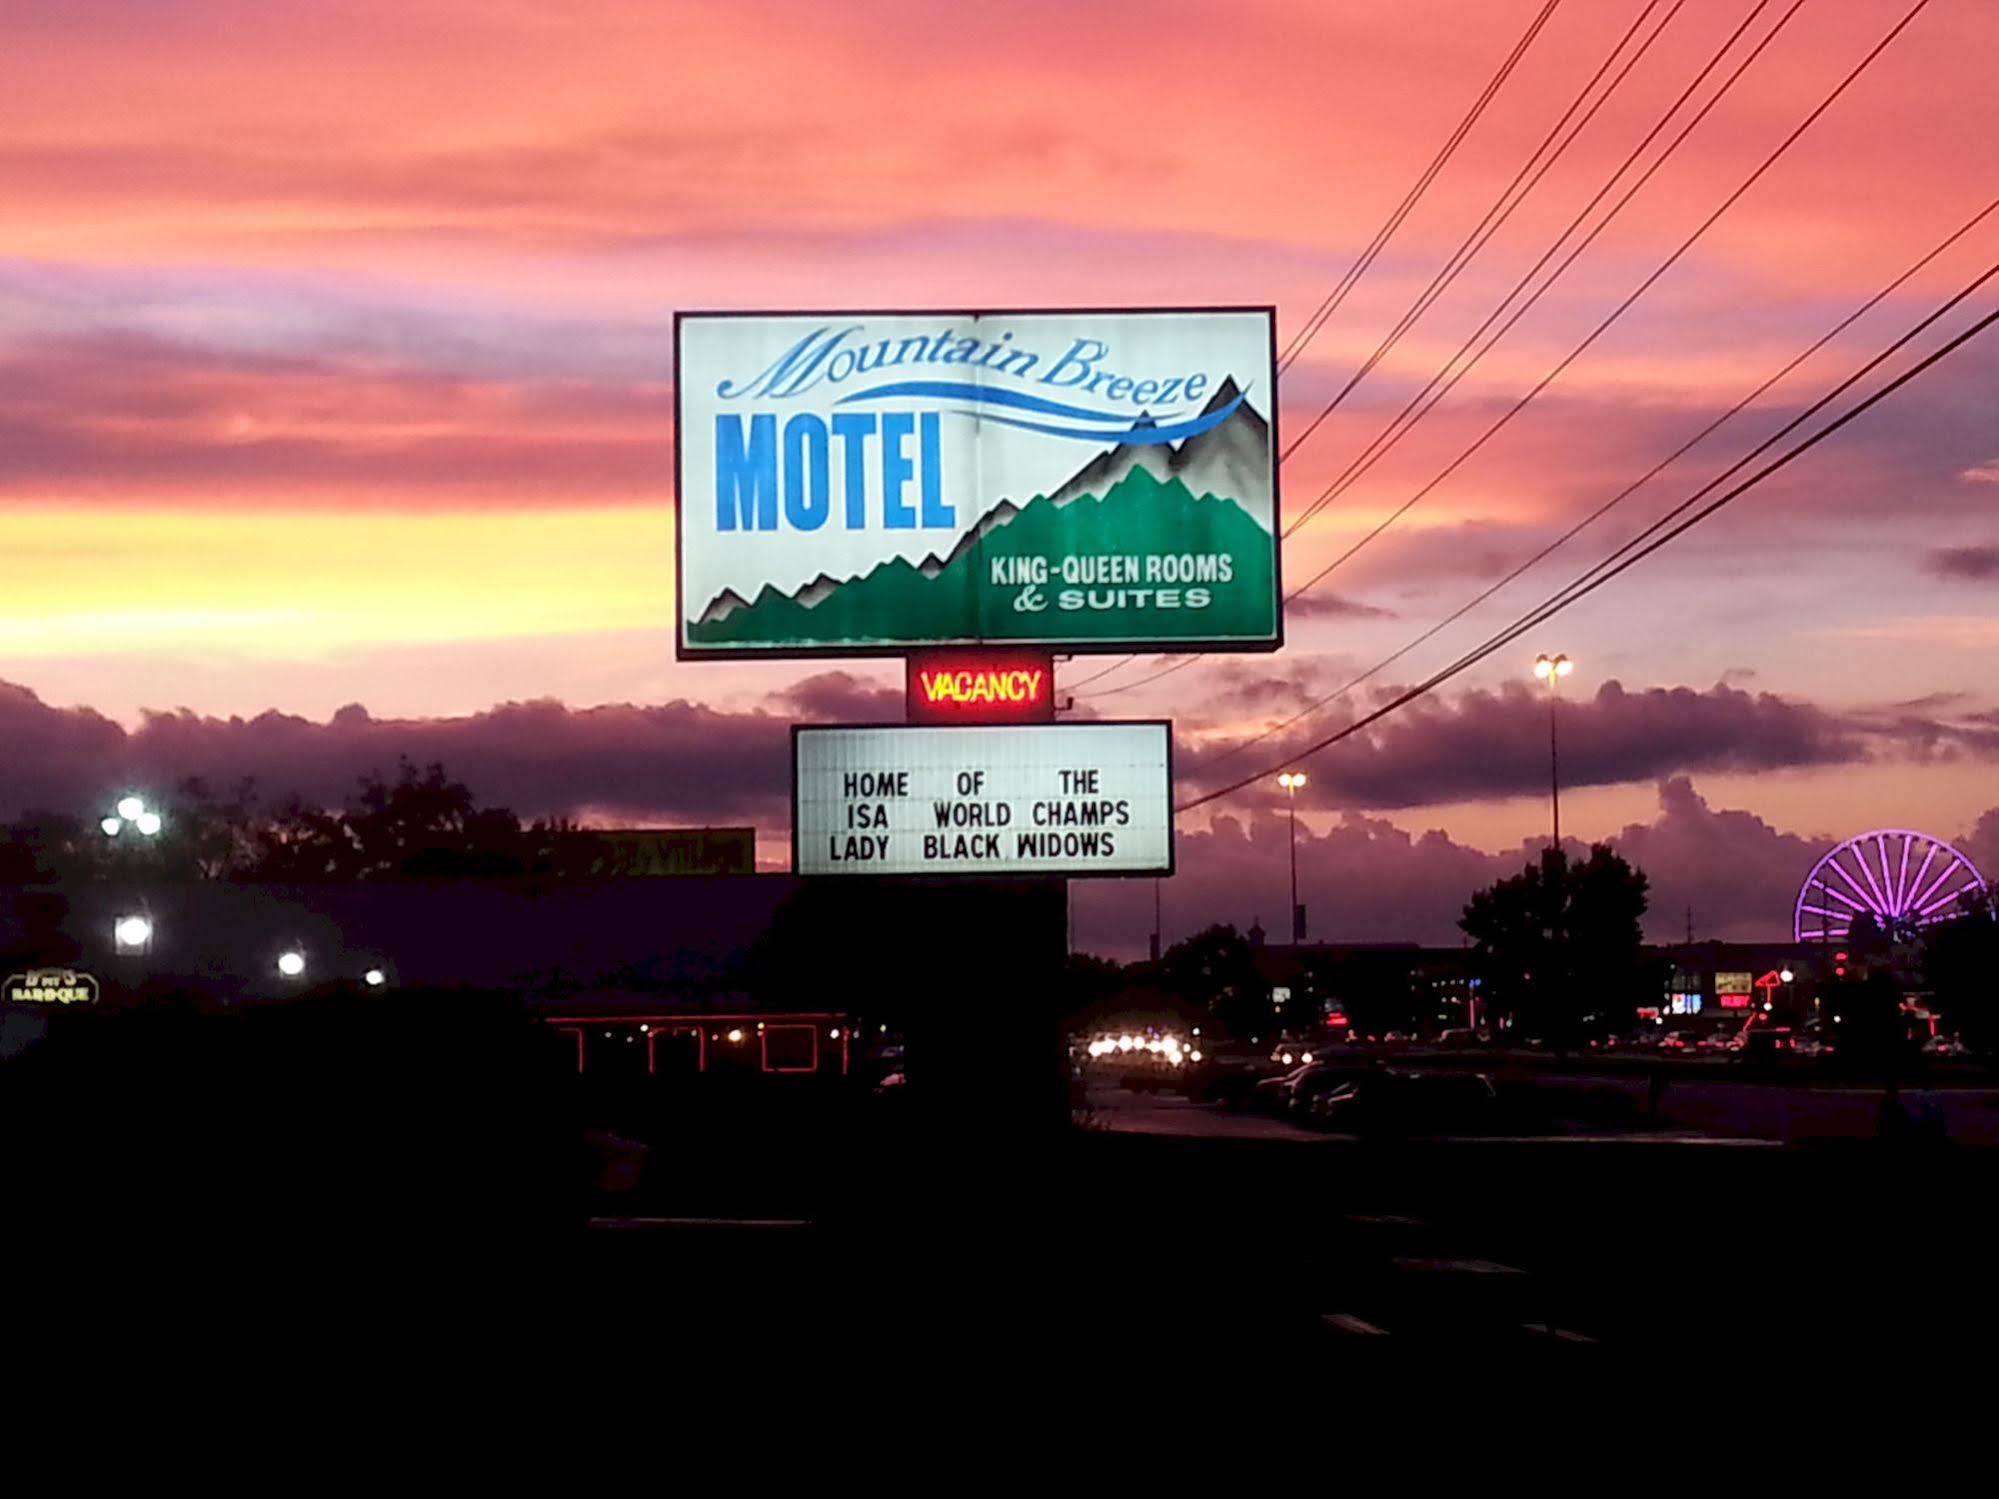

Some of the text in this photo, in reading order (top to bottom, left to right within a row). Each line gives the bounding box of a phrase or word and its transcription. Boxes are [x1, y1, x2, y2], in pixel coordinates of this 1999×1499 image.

[716, 325, 1207, 405] Mountain Breeze
[716, 412, 956, 532] MOTEL
[991, 553, 1233, 585] KING-QUEEN ROOMS
[1013, 588, 1211, 612] & SUITES
[920, 670, 1041, 702] VACANCY
[843, 770, 1099, 797] HOME OF THE
[848, 800, 1129, 829] ISA WORLD CHAMPS
[830, 832, 1115, 861] LADY BLACK WIDOWS
